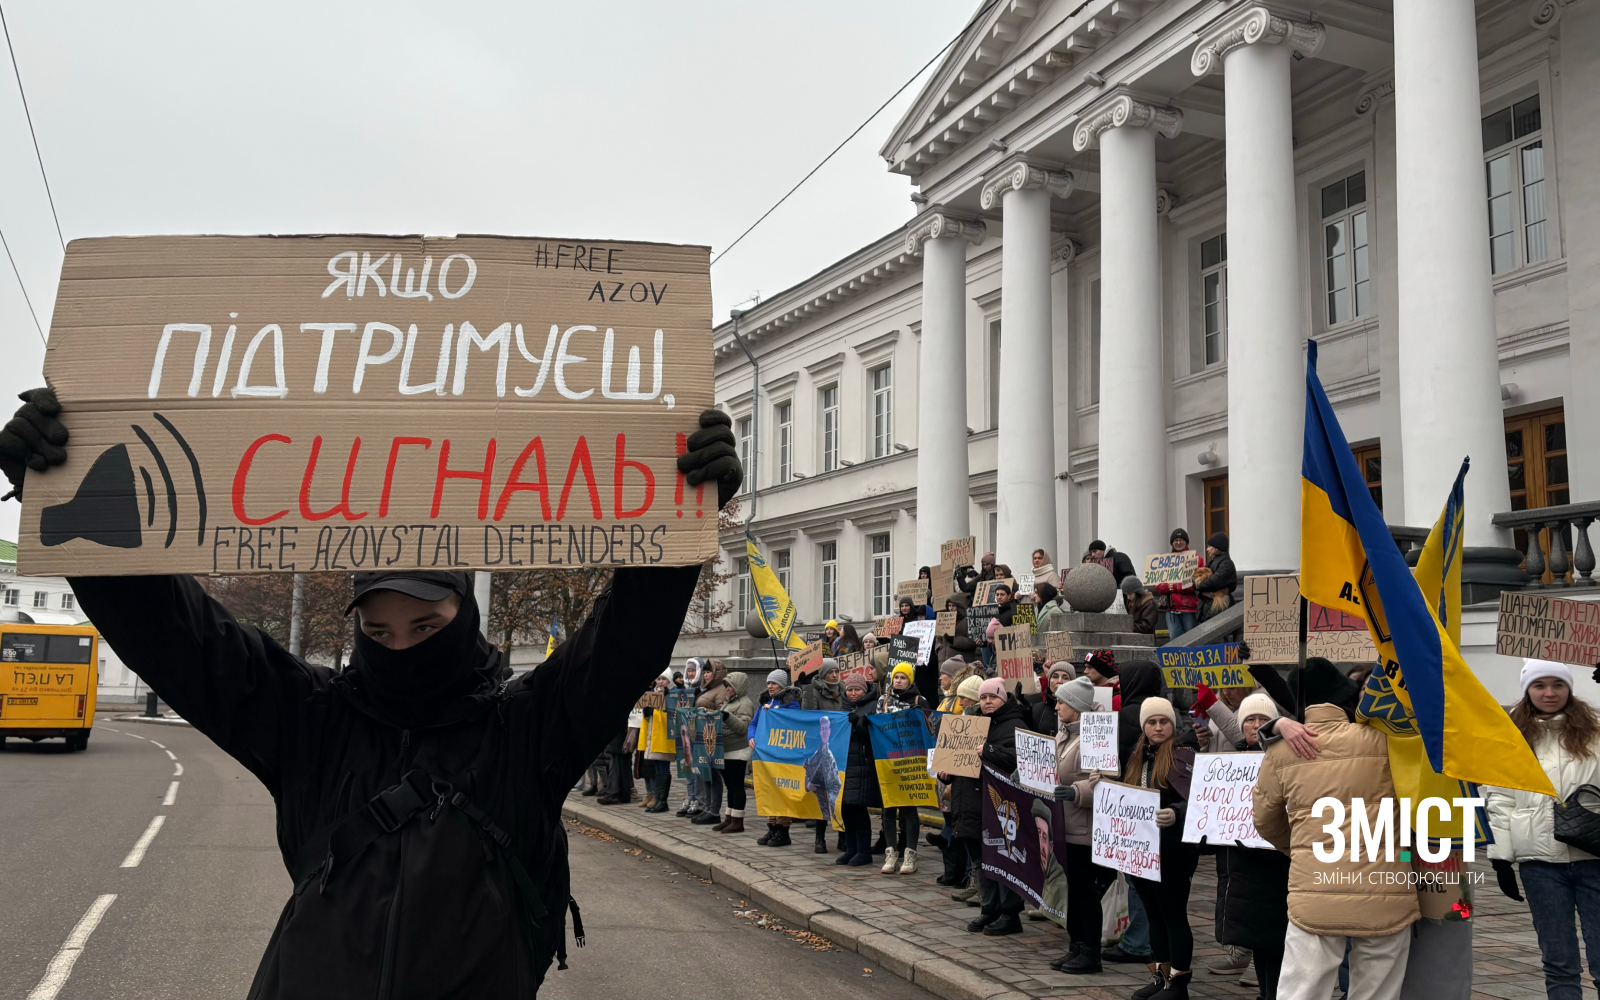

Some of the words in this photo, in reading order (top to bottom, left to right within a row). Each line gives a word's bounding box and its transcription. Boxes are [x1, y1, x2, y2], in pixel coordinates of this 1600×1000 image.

[534, 244, 624, 275] #FREE
[321, 251, 478, 300] ЯКЩО
[588, 281, 668, 306] AZOV
[148, 312, 676, 410] ПІДТРИМУЄШ,
[213, 526, 299, 571] FREE
[310, 524, 470, 571] AZOVSTAL
[484, 523, 668, 568] DEFENDERS
[1020, 575, 1034, 583] FREE
[1016, 605, 1033, 614] FREE
[1500, 593, 1549, 619] ШАНУЙ
[1552, 600, 1600, 626] ПОЛЕГЛ
[1264, 622, 1299, 635] ПІХОТ
[1497, 613, 1565, 641] ДОПОМАГАЙ
[893, 638, 907, 649] БУДЬ
[1309, 630, 1363, 647] АЗОВ
[1497, 634, 1541, 659] КРИЧИ
[1162, 649, 1205, 667] БОРІТЬСЯ
[1205, 648, 1221, 665] ЗА
[1224, 644, 1242, 664] НИ
[1221, 668, 1244, 686] ВАС
[767, 728, 807, 750] МЕДИК
[1017, 733, 1051, 756] ПОВЕРНІТЬ
[777, 777, 801, 790] БРИГАДА
[1203, 757, 1260, 788] Поверні
[1096, 788, 1117, 816] Ми
[1118, 795, 1155, 821] боремося
[1196, 786, 1235, 805] мого
[1110, 818, 1137, 837] РАЗОМ
[1237, 823, 1262, 841] ДШ
[1094, 828, 1111, 845] Він
[1120, 838, 1151, 852] життя
[1094, 843, 1103, 857] Я
[981, 863, 1007, 878] ОКРЕМА
